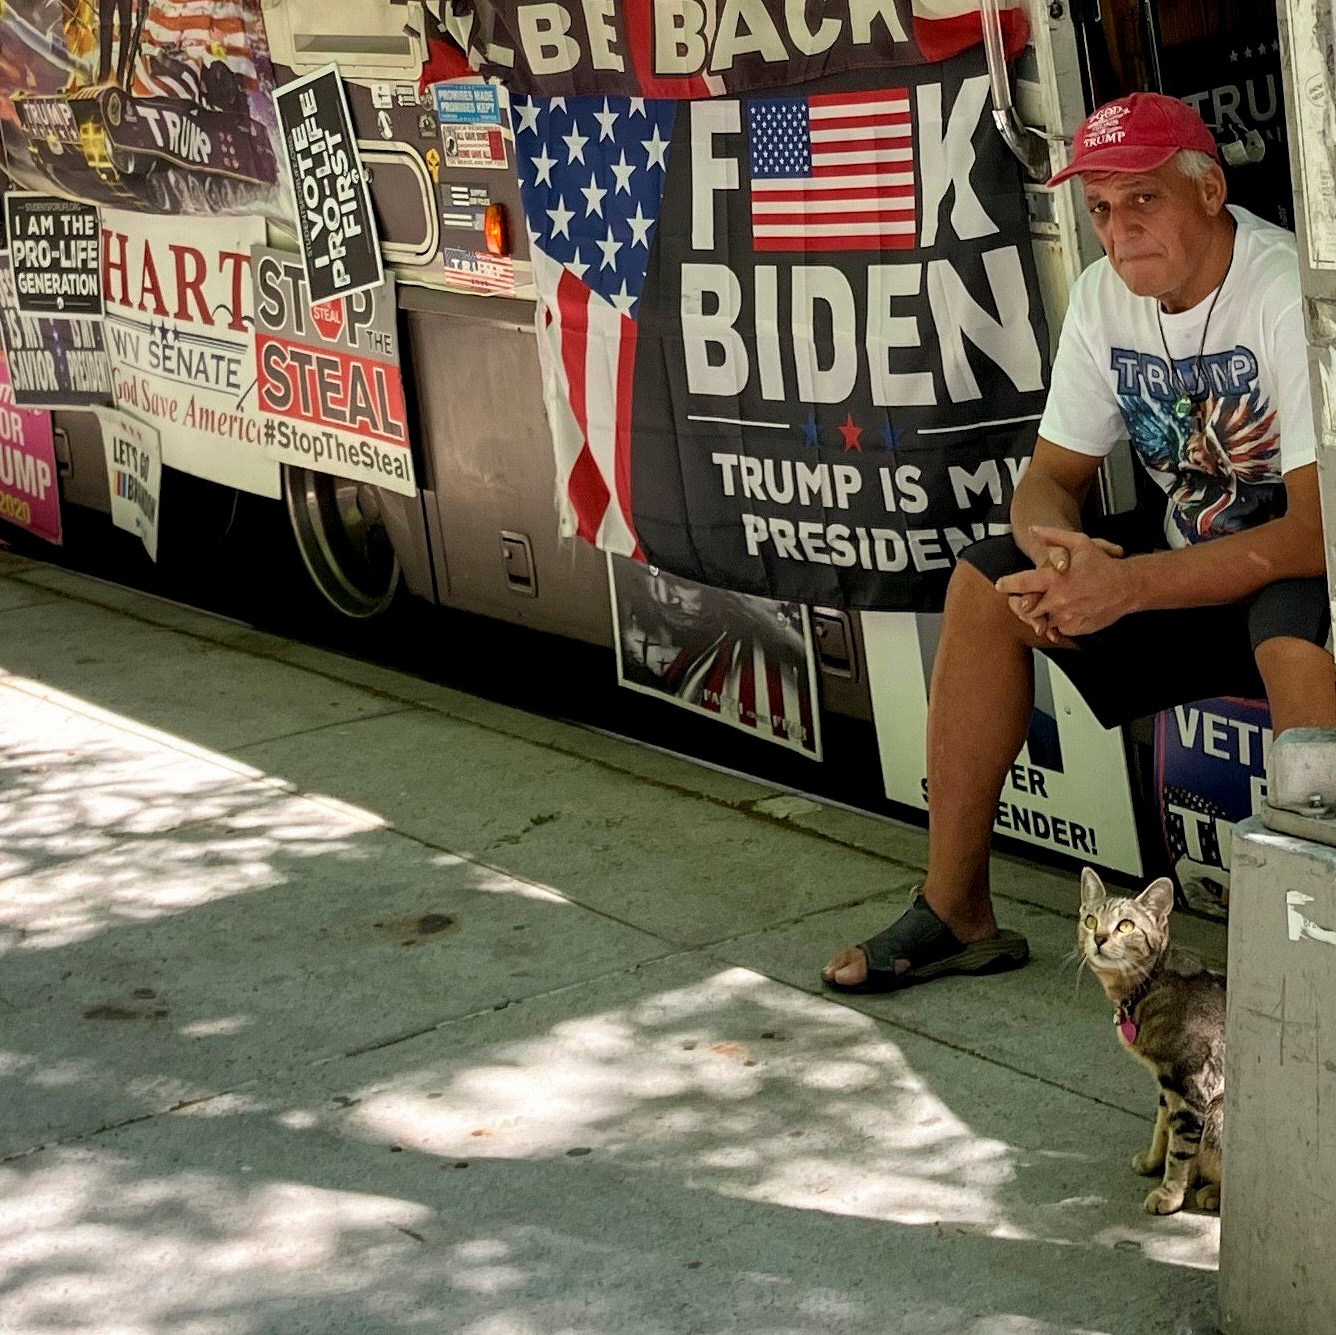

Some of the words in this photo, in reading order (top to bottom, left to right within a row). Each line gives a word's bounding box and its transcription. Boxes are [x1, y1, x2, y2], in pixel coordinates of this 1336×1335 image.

[135, 105, 213, 164] TRUMP
[1083, 131, 1126, 147] TRUMP
[291, 122, 324, 242] VOTE
[299, 88, 351, 289] PRO-LIFE
[324, 130, 362, 239] FIRST
[13, 240, 98, 269] PRO-LIFE
[15, 215, 21, 236] I
[27, 215, 55, 236] AM
[60, 215, 95, 236] THE
[17, 272, 99, 297] GENERATION
[313, 304, 343, 326] STEAL
[366, 330, 393, 356] THE
[680, 243, 1045, 408] BIDEN
[9, 350, 60, 391] SAVIOR
[111, 326, 141, 358] WV
[148, 337, 242, 391] SENATE
[1112, 345, 1259, 401] TRUMP
[112, 367, 139, 408] God
[142, 382, 178, 425] Save
[186, 398, 261, 448] Americ
[260, 343, 405, 441] STEAL
[263, 418, 411, 482] #StopTheSteal
[711, 452, 863, 514] TRUMP
[878, 467, 929, 514] IS
